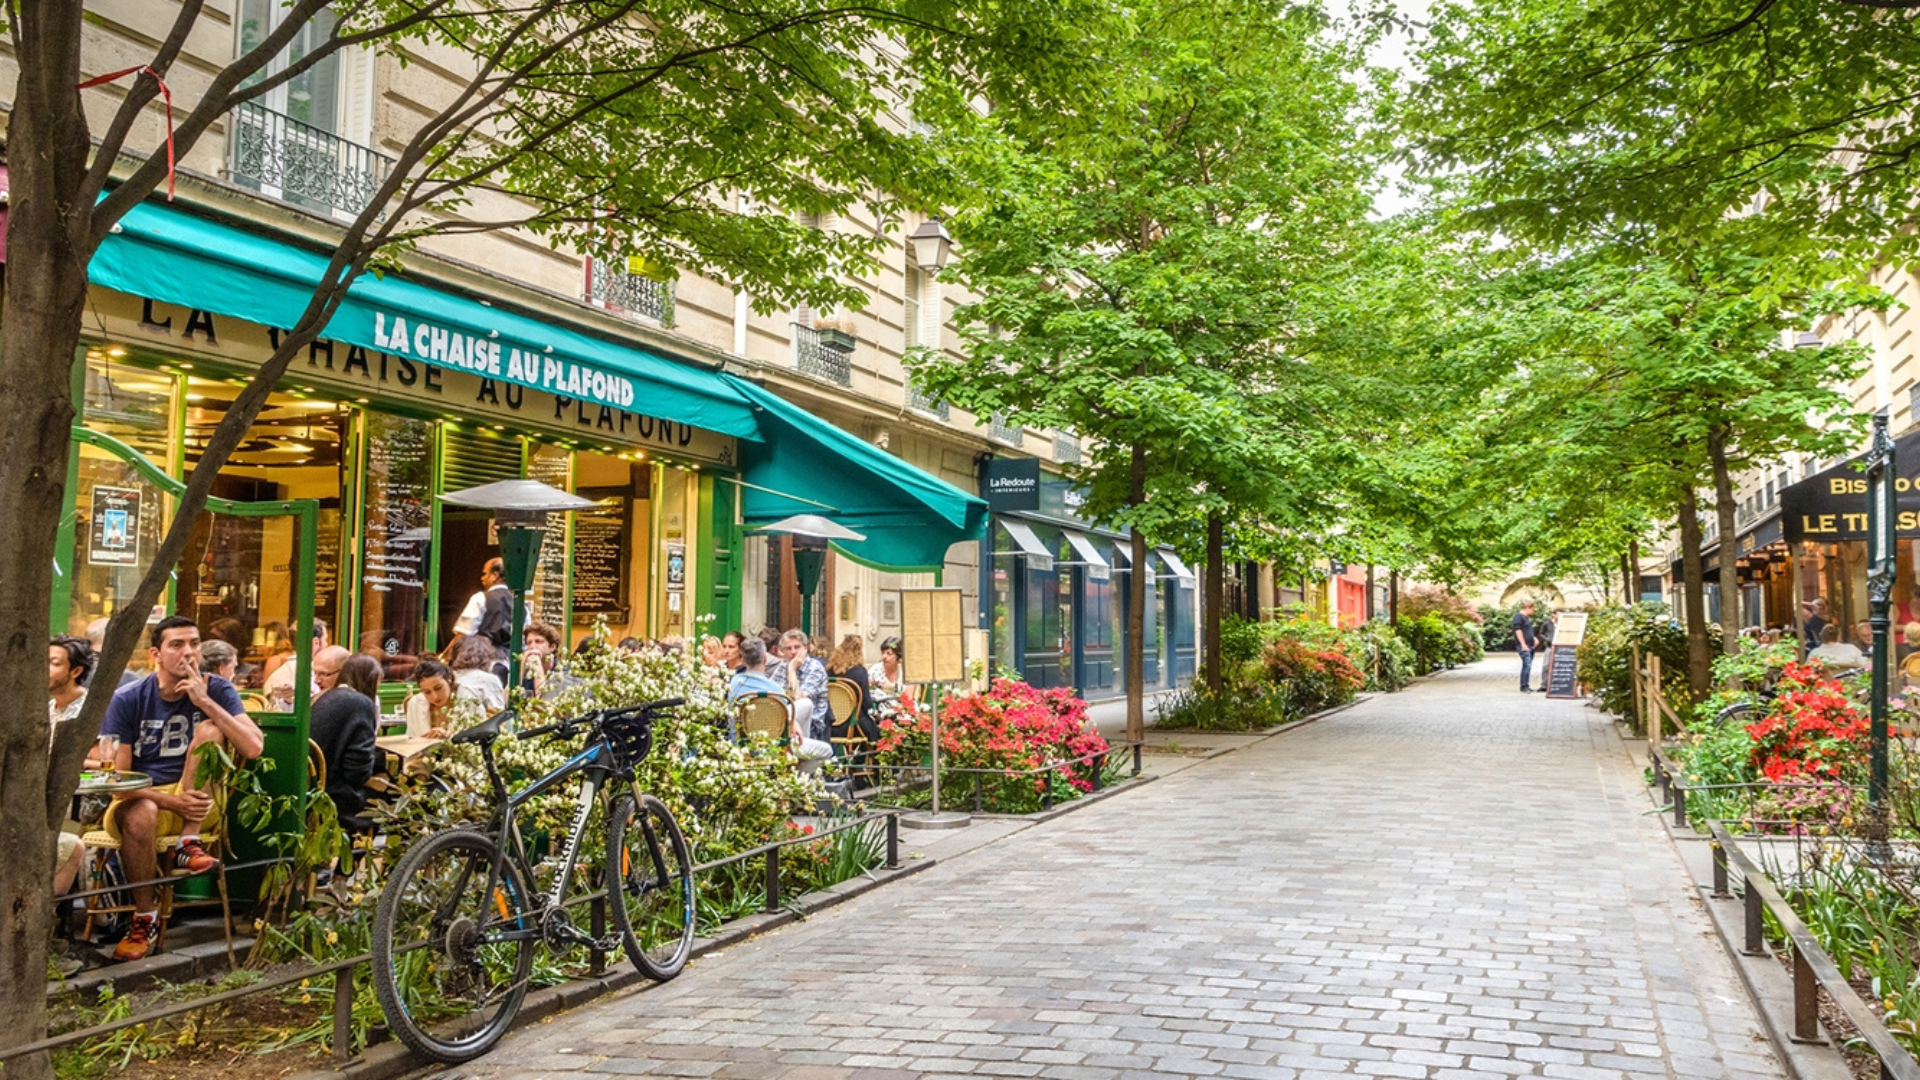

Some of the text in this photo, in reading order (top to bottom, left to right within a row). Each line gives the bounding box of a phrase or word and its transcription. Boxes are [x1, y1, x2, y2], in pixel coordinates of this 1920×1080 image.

[138, 298, 219, 347] LA
[476, 378, 524, 410] AU
[554, 395, 692, 447] PLAFOND
[374, 311, 634, 407] LA CHAISE AU PLAFOND
[990, 478, 1036, 487] La Redoute
[1829, 477, 1911, 495] BISO
[1802, 513, 1838, 533] LE
[549, 803, 586, 896] ROCKRIDER
